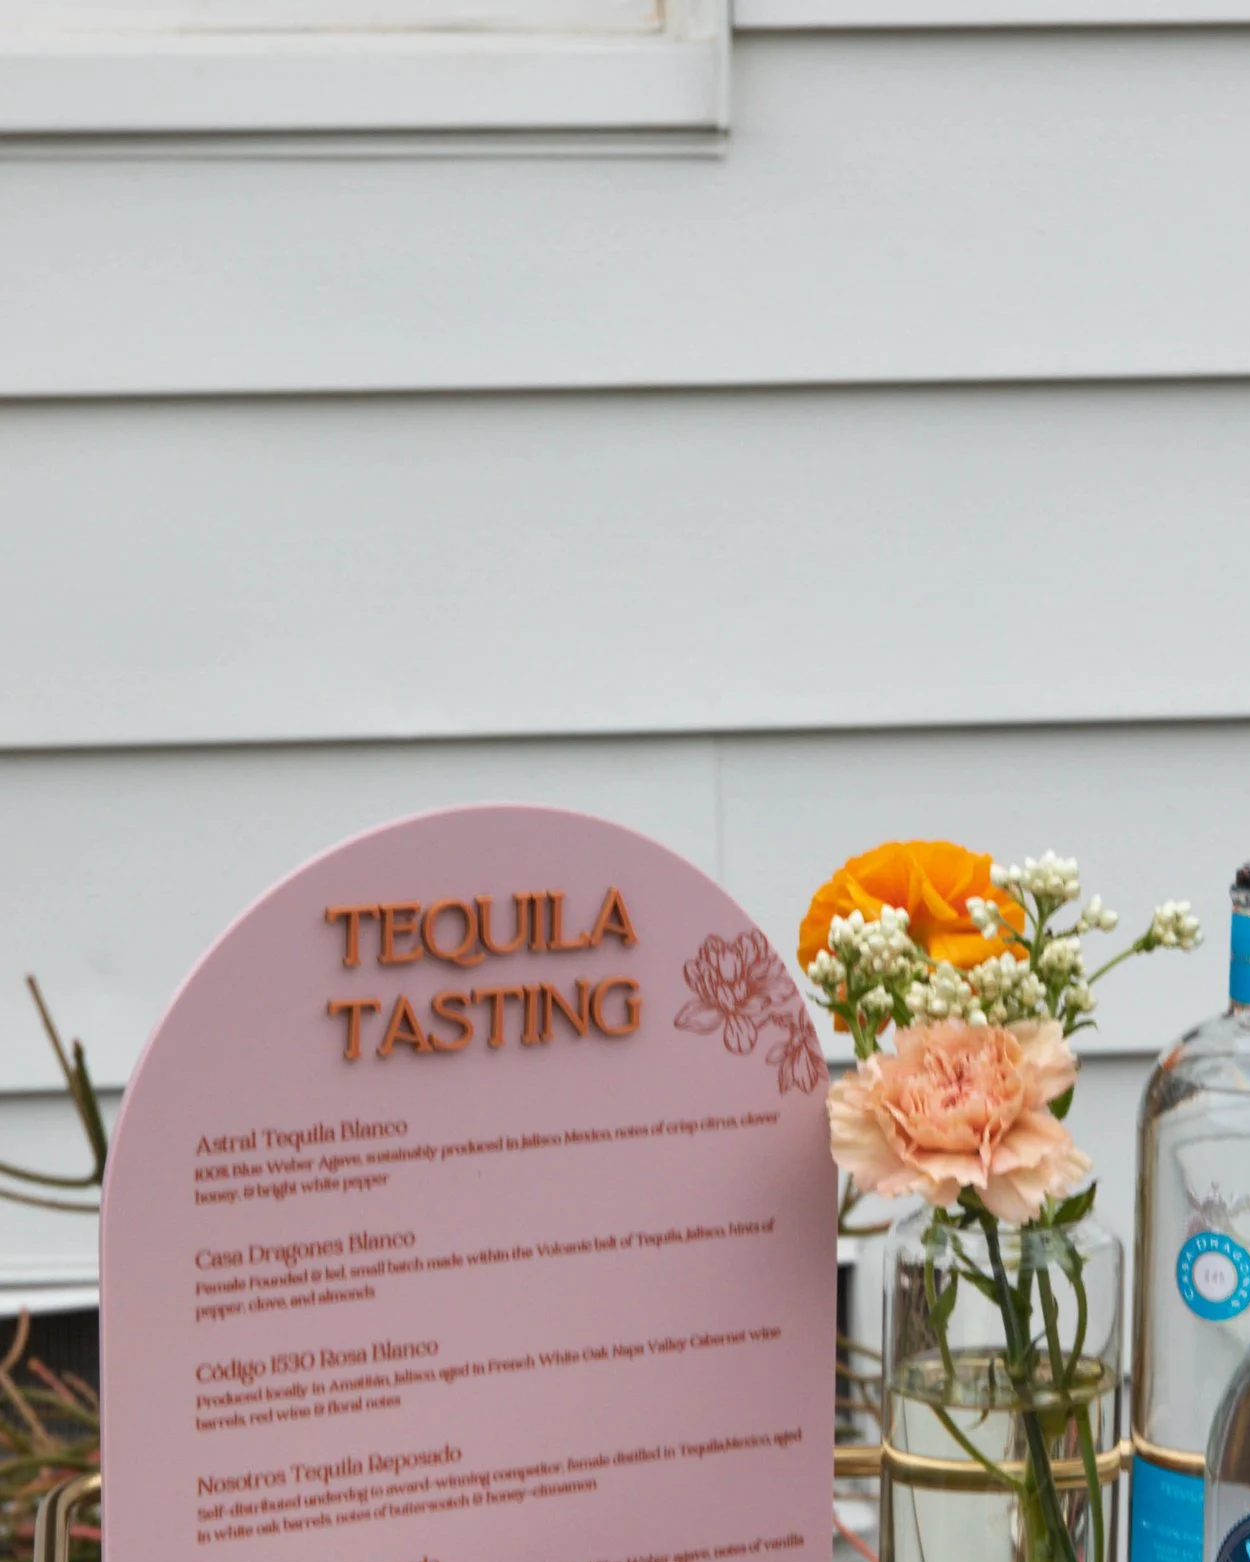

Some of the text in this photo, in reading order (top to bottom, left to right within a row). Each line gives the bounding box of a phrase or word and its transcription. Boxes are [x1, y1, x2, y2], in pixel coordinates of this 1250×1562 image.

[325, 883, 638, 967] TEQUILA
[326, 976, 643, 1060] TASTING
[196, 1119, 408, 1154] Astral Tequila Blanco
[267, 1158, 312, 1174] Weber
[441, 1138, 502, 1162] produced
[506, 1137, 519, 1151] in
[651, 1121, 666, 1137] of
[256, 1178, 298, 1198] bright
[302, 1175, 340, 1192] white
[342, 1173, 389, 1192] pepper
[195, 1232, 416, 1269] Casa Dragones Blanco
[195, 1276, 246, 1295] Female
[250, 1268, 308, 1288] Founded
[350, 1259, 385, 1277] small
[387, 1255, 422, 1273] batch
[427, 1251, 463, 1268] made
[467, 1246, 509, 1264] within
[512, 1244, 532, 1259] the
[620, 1232, 633, 1248] of
[762, 1217, 776, 1232] of
[290, 1291, 316, 1307] and
[319, 1285, 376, 1304] almonds
[195, 1387, 262, 1409] Produced
[265, 1382, 308, 1401] locally
[312, 1381, 325, 1395] in
[473, 1361, 485, 1376] in
[488, 1354, 535, 1374] French
[540, 1350, 580, 1367] White
[612, 1344, 645, 1360] Napa
[648, 1337, 687, 1354] Valley
[271, 1350, 315, 1374] 1530
[320, 1349, 367, 1368] Rosa
[372, 1341, 439, 1362] Blanco
[250, 1408, 273, 1424] red
[277, 1405, 311, 1421] wine
[327, 1396, 362, 1414] floral
[366, 1393, 400, 1410] notes
[197, 1445, 462, 1495] Nosotros Tequila Reposado
[304, 1486, 367, 1506] underdog
[370, 1483, 384, 1497] to
[664, 1445, 676, 1459] in
[214, 1523, 253, 1541] white
[256, 1518, 280, 1535] oak
[336, 1506, 371, 1523] notes
[374, 1502, 387, 1517] of
[749, 1538, 762, 1553] of
